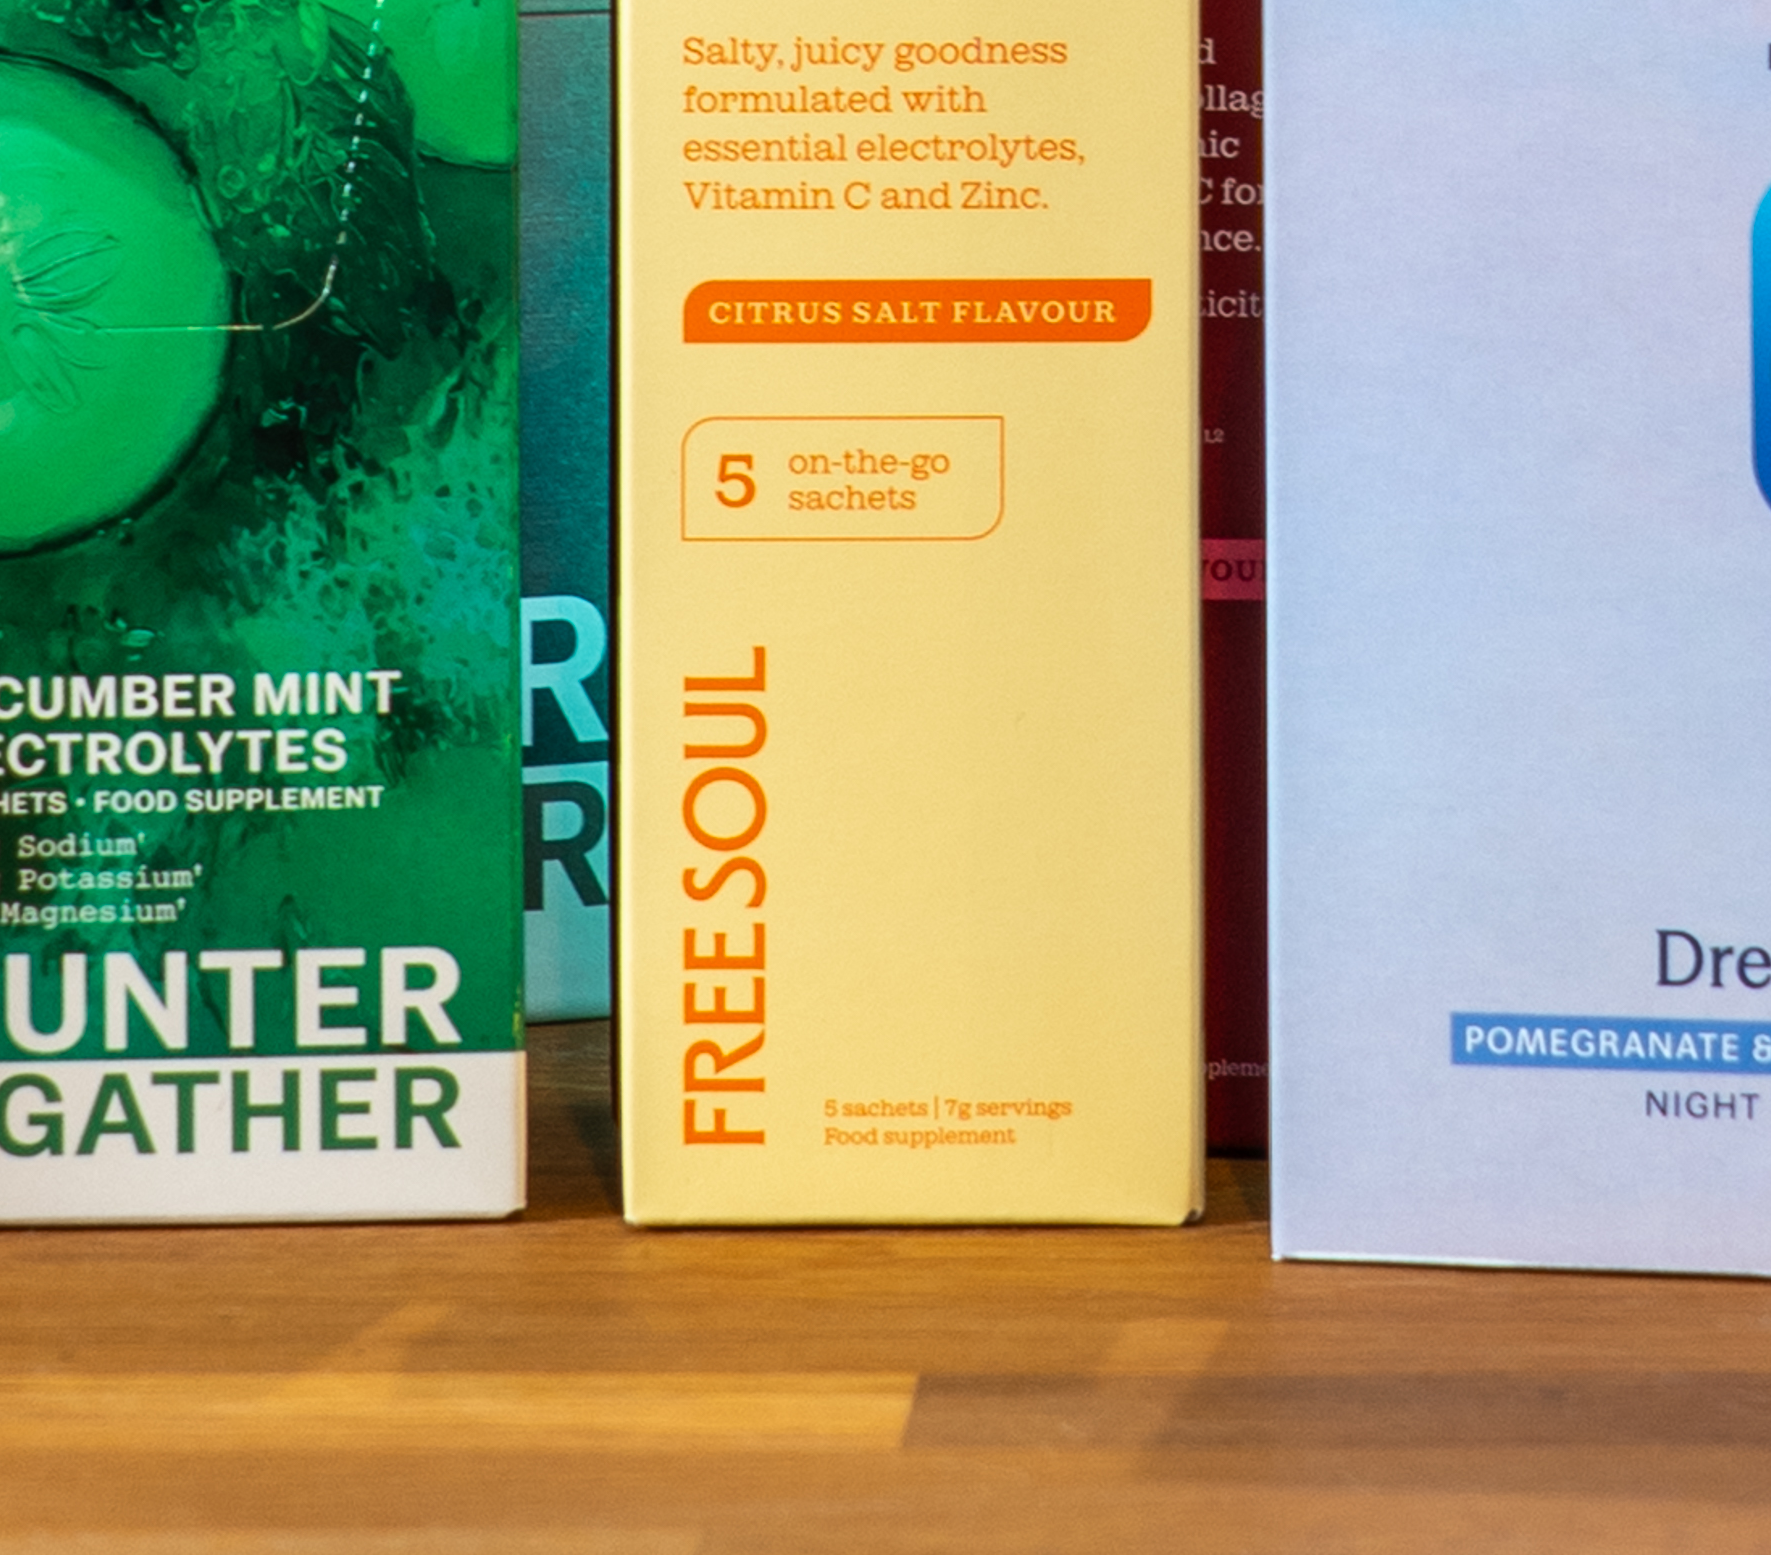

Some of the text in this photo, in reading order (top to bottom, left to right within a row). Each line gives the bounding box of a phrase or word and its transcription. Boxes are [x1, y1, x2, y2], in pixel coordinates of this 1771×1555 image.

[682, 36, 1068, 71] Salty, juicy goodness
[682, 85, 987, 114] formulated with
[682, 133, 1086, 168] essential electrolytes,
[683, 181, 1049, 210] Vitamin and Zinc.
[709, 300, 1116, 324] CITRUS SALT FLAVOUR
[788, 449, 951, 481] on-the-go
[788, 484, 917, 511] sachets
[253, 670, 402, 716] MINT
[93, 789, 179, 814] FOOD
[185, 785, 383, 813] SUPPLEMENT
[1464, 1024, 1740, 1065] POMEGRANATE
[842, 1098, 928, 1117] sachets
[1644, 1090, 1757, 1121] NIGHT
[883, 1127, 1016, 1149] supplement
